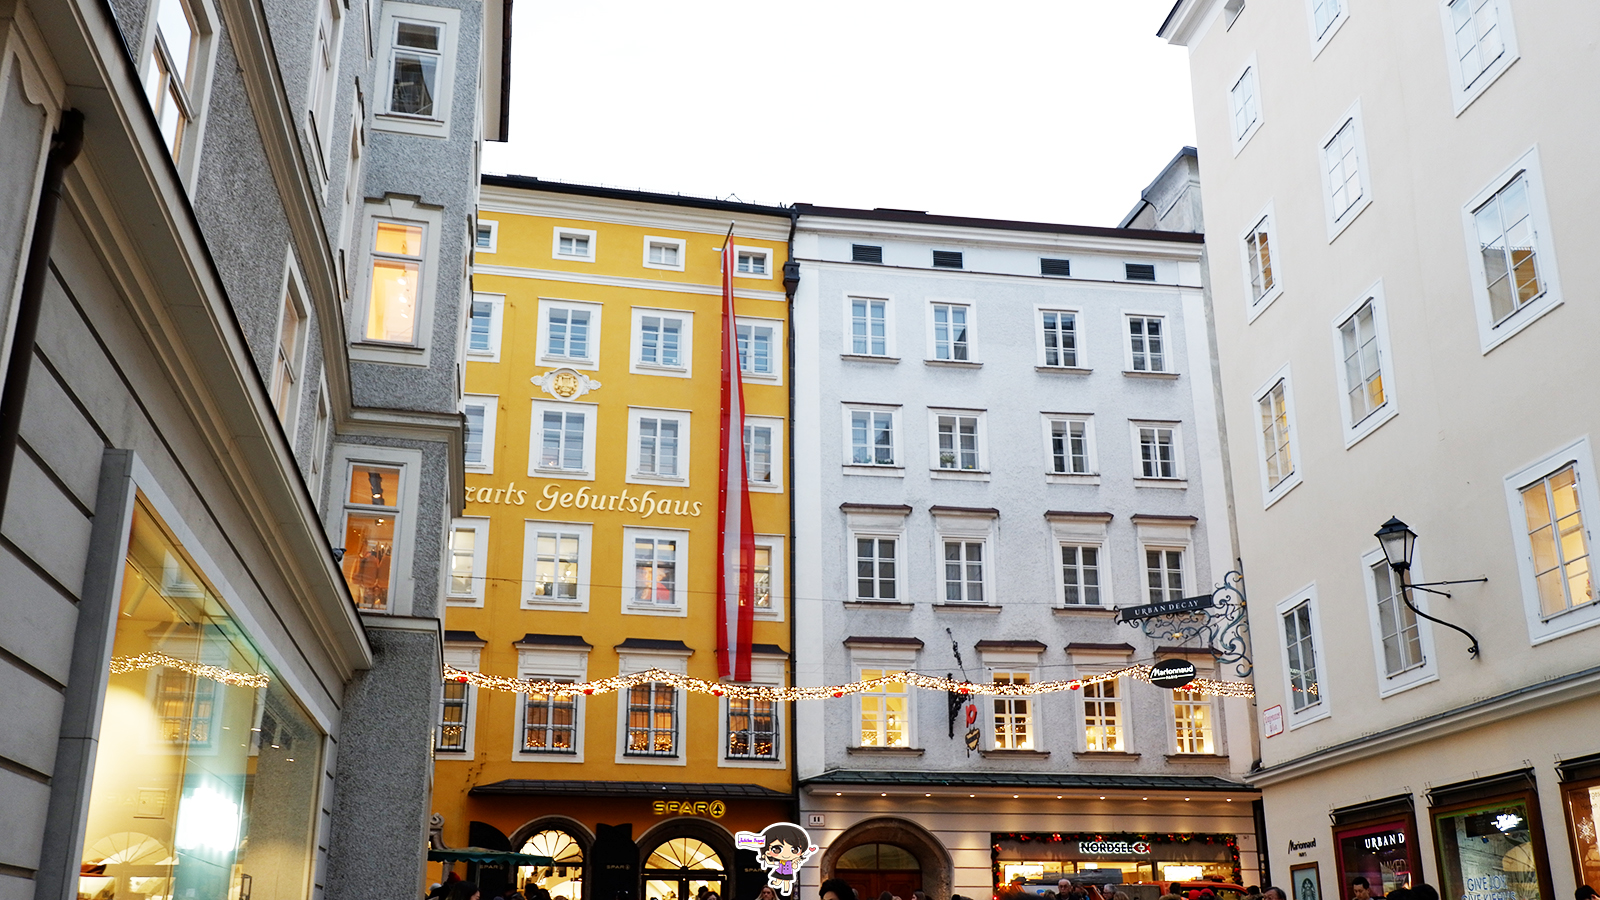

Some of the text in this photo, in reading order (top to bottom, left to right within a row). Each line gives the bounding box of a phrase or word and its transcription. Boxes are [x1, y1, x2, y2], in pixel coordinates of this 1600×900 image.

[535, 483, 703, 519] Geburtshaus
[1134, 600, 1199, 616] URBAN DECAY
[653, 801, 710, 815] SPAR
[1079, 842, 1133, 854] NORDSEE
[1364, 834, 1397, 850] URBAN
[1467, 878, 1488, 892] GIVE
